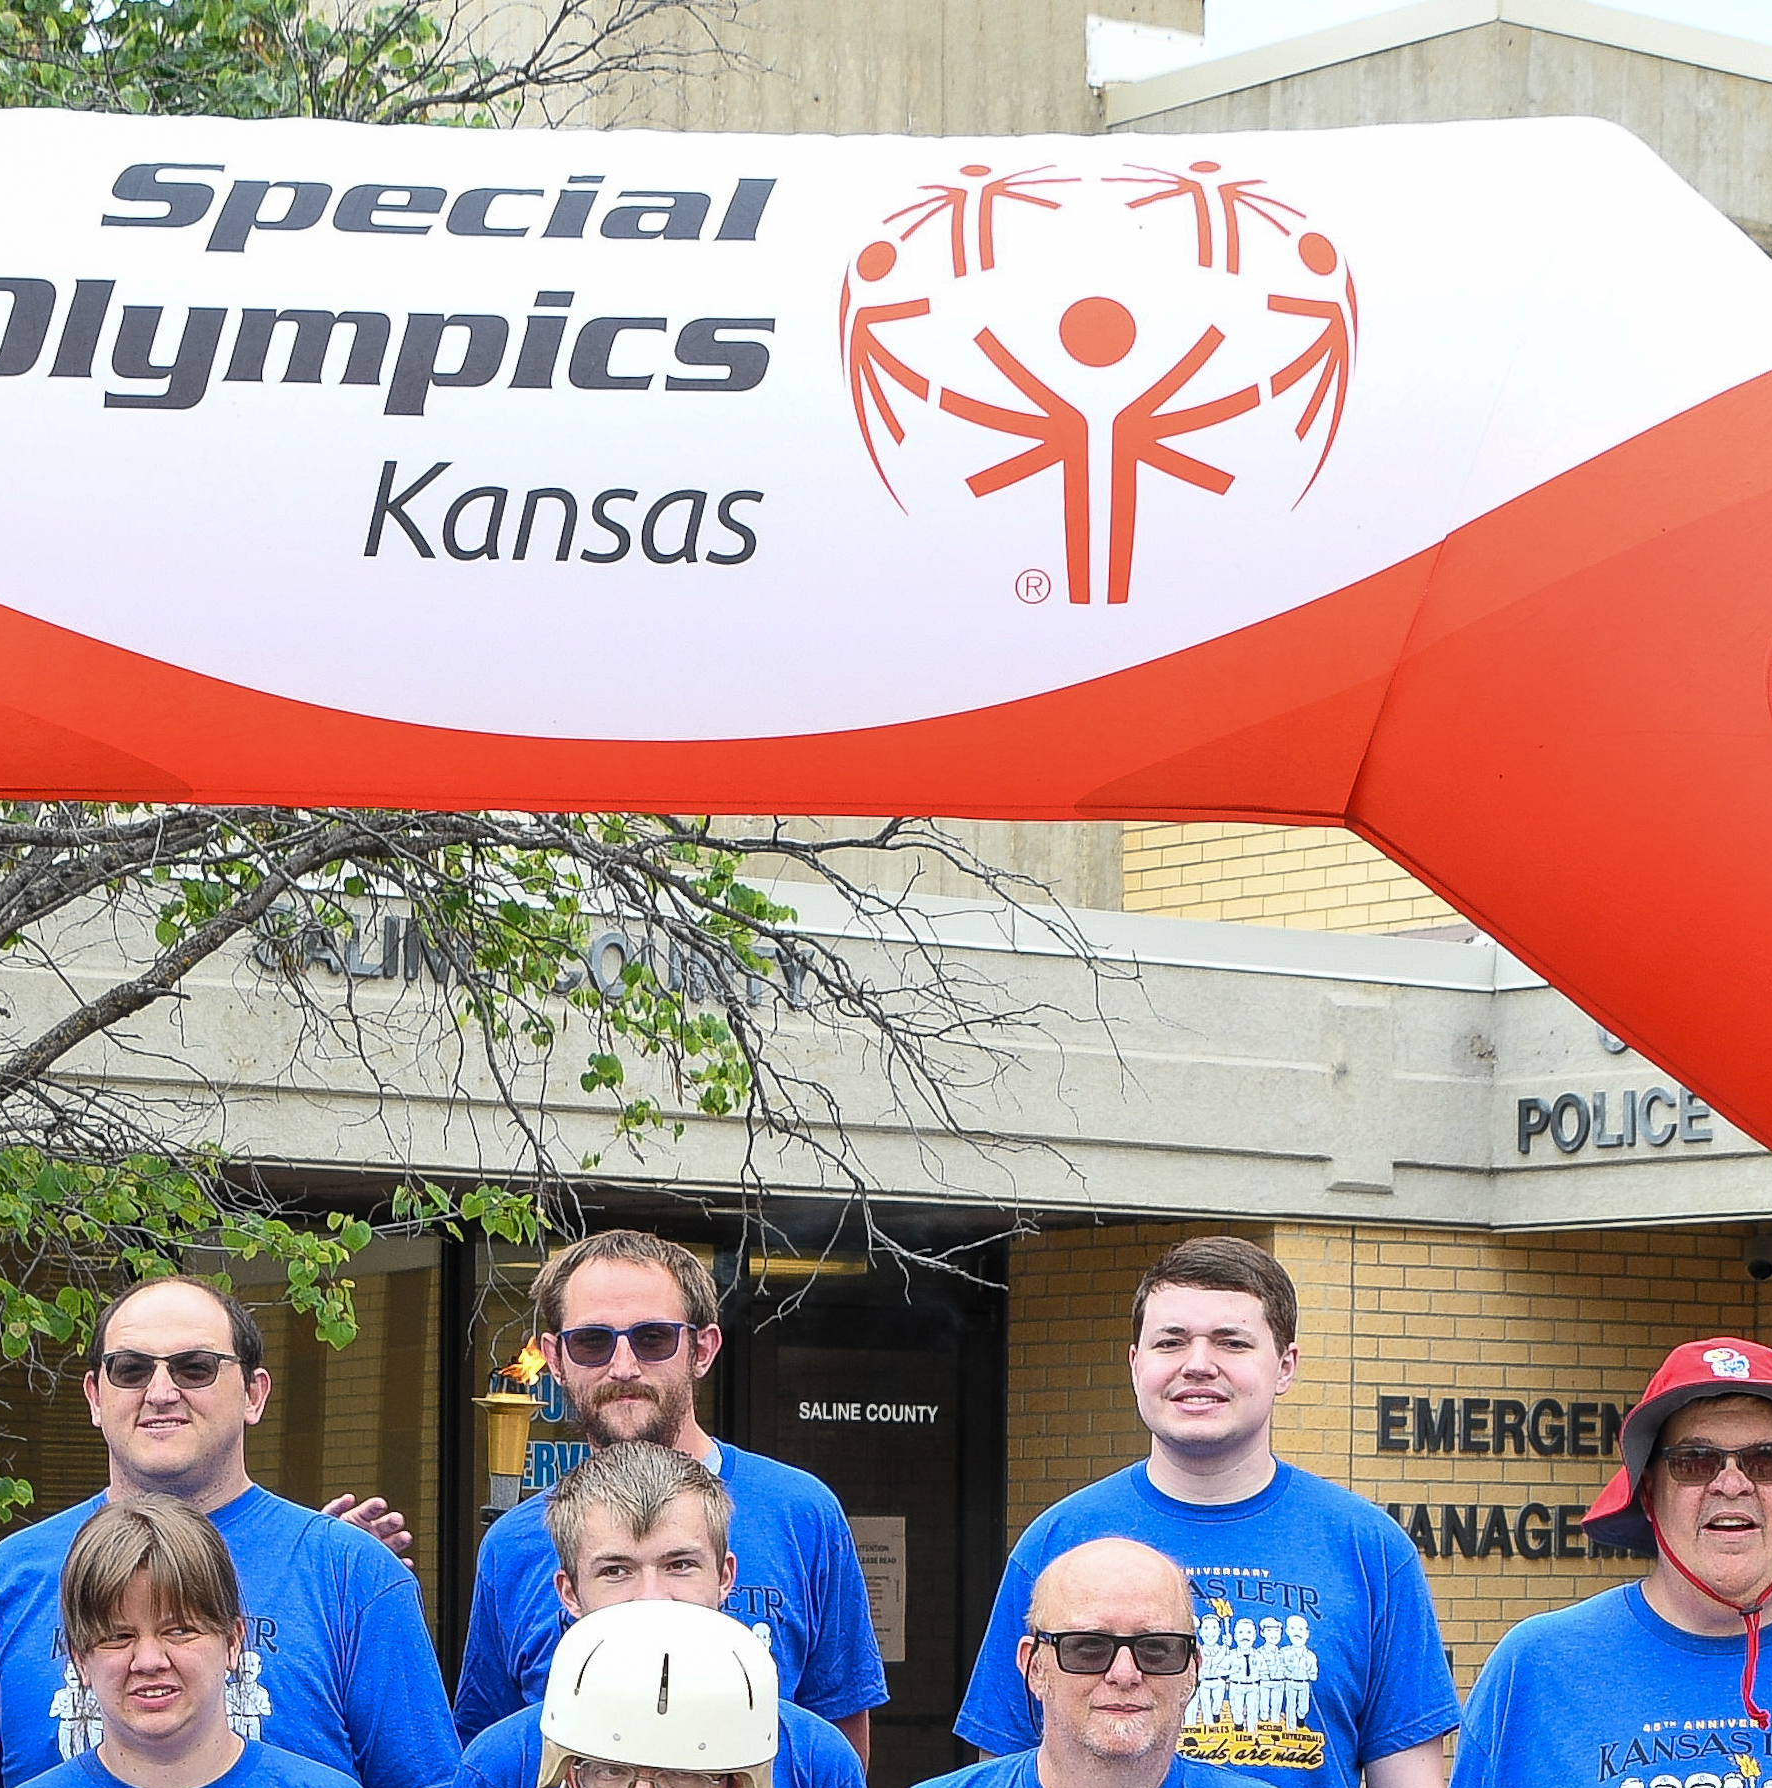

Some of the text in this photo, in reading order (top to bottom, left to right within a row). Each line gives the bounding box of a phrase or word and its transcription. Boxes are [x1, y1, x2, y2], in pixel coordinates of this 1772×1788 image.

[101, 161, 777, 254] Special
[363, 460, 764, 565] Kansas
[1517, 1086, 1714, 1154] POLICE
[799, 1402, 938, 1423] SALINE COUNTY
[1235, 1580, 1322, 1620] LETR
[1234, 1745, 1322, 1765] are made
[1599, 1732, 1752, 1783] KANSAS
